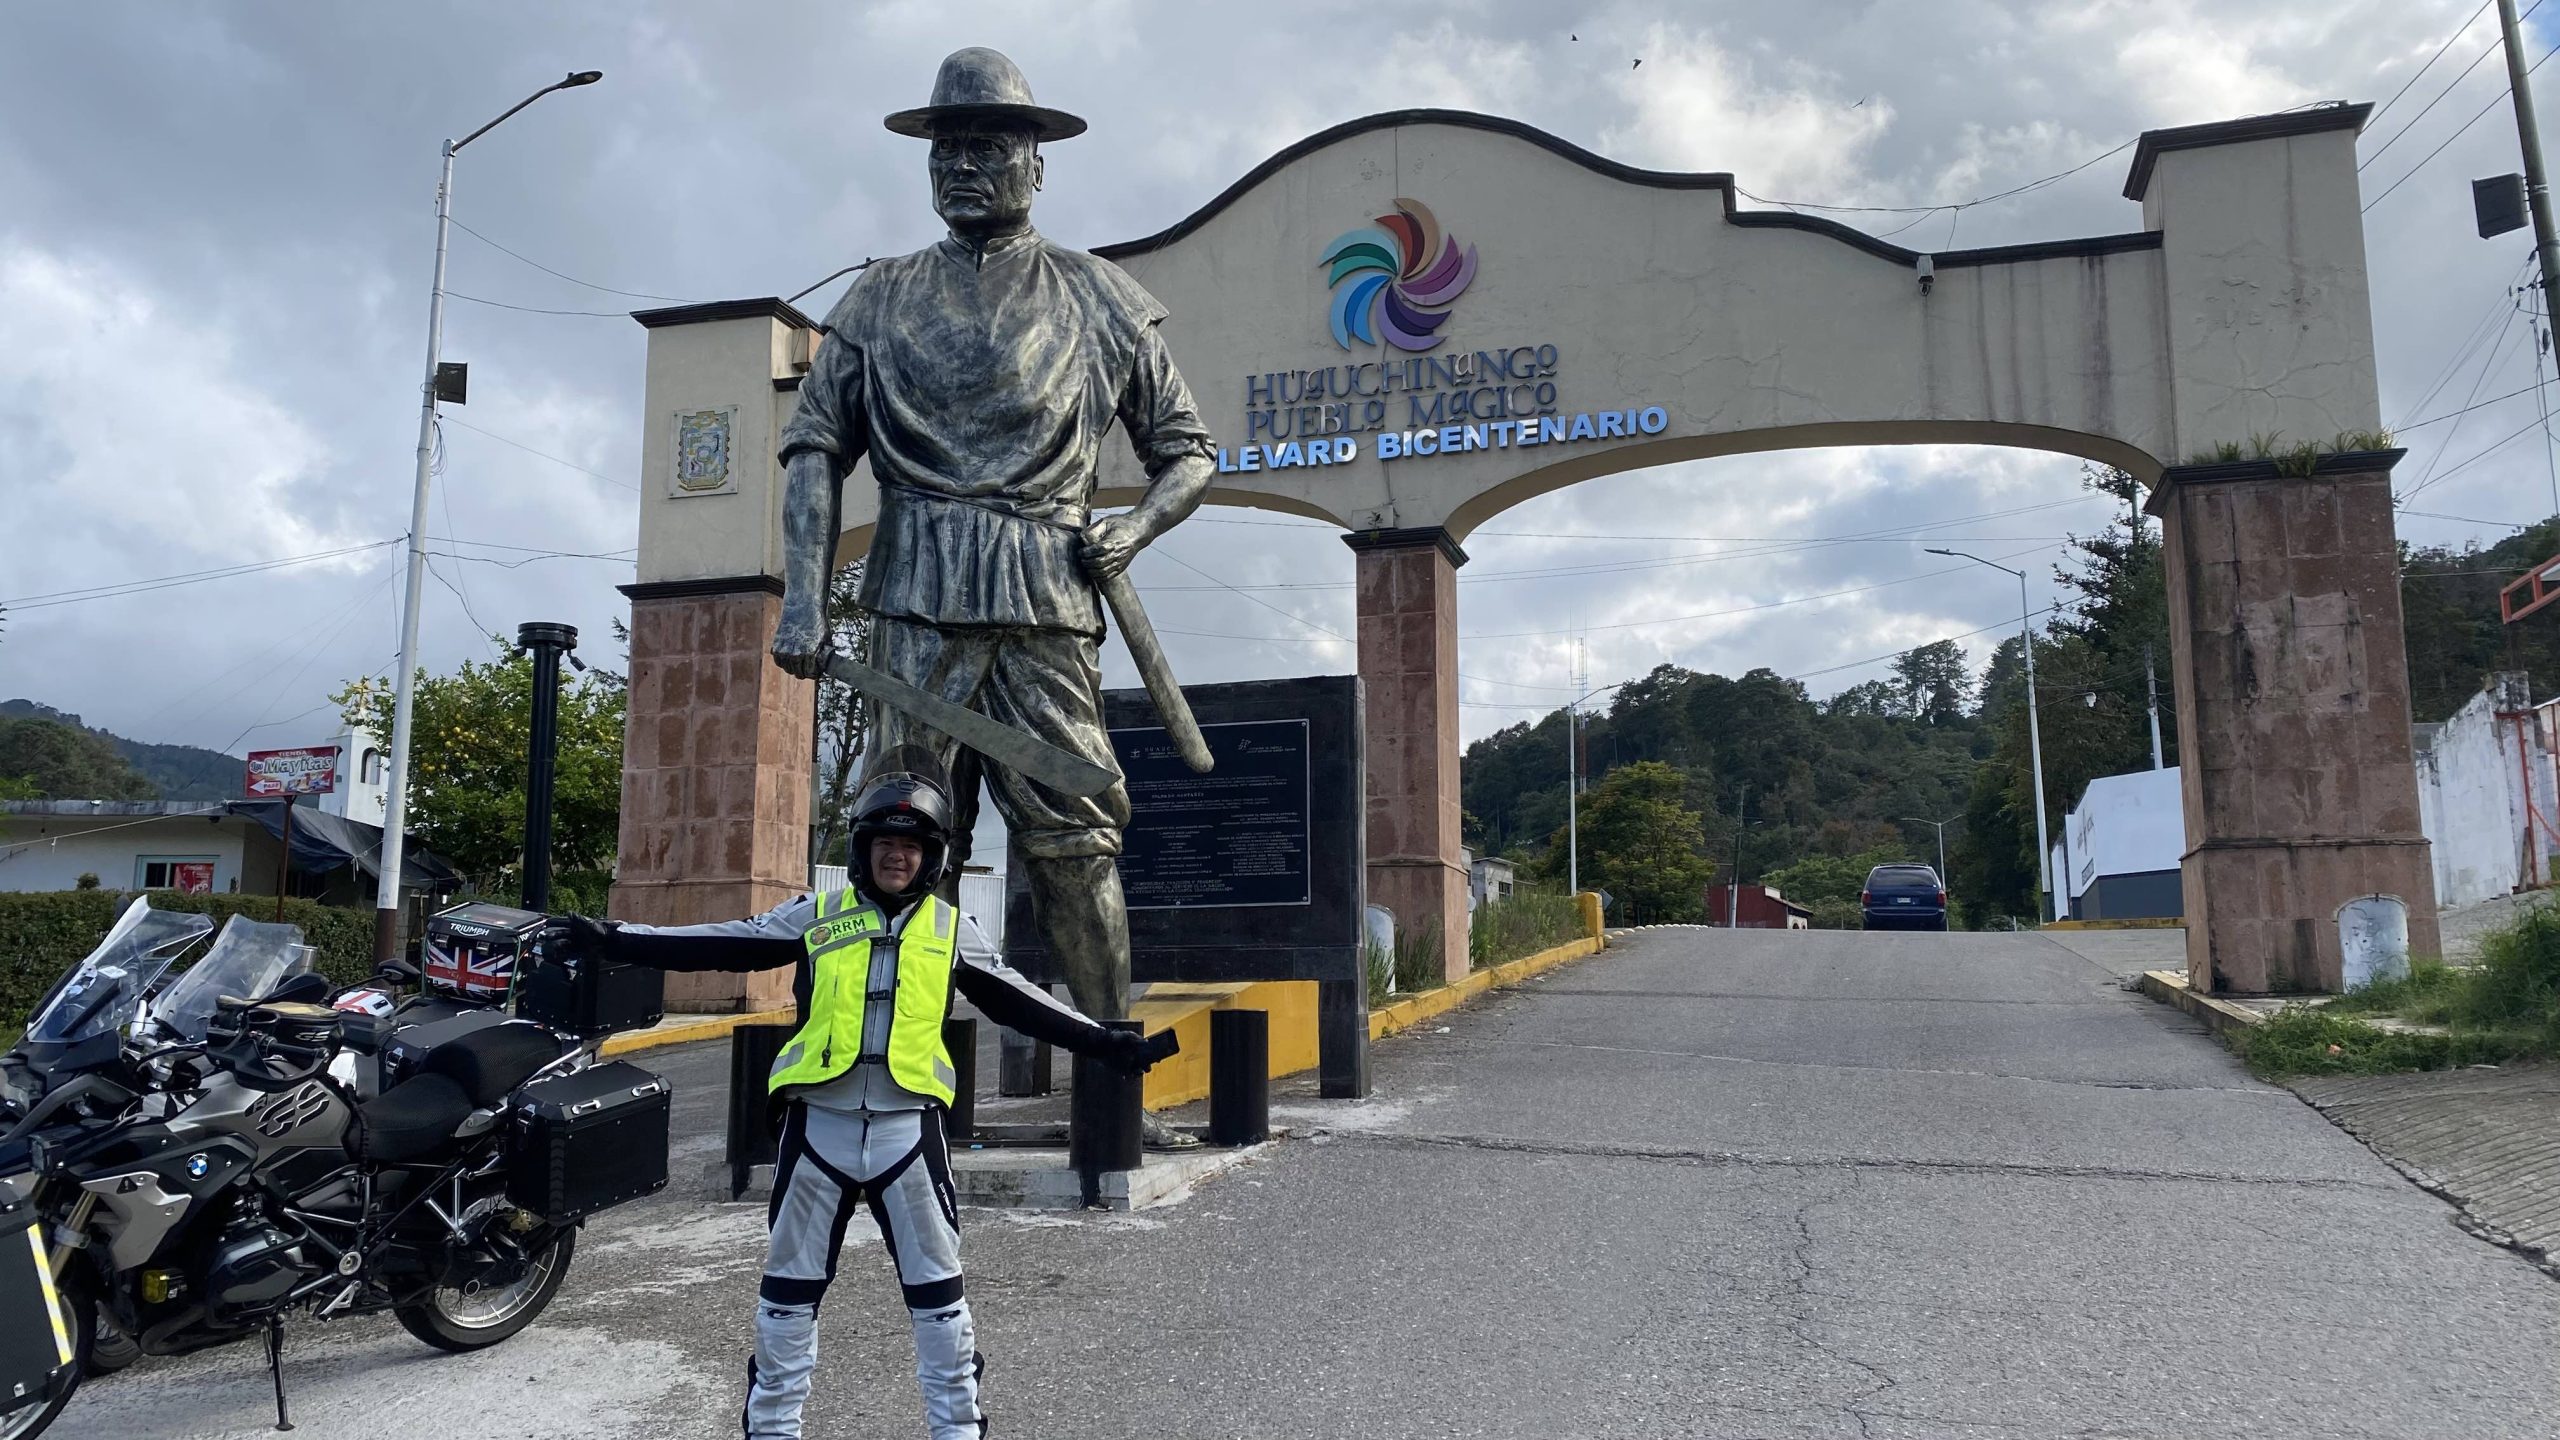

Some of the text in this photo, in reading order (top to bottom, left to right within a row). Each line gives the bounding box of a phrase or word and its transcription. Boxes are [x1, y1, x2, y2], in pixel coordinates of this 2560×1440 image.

[1218, 406, 1669, 473] LEVARD BICENTENARIO
[264, 756, 334, 776] Mayitas
[450, 922, 490, 936] TRIUMPH
[831, 918, 866, 936] RRM
[256, 1082, 330, 1138] GS
